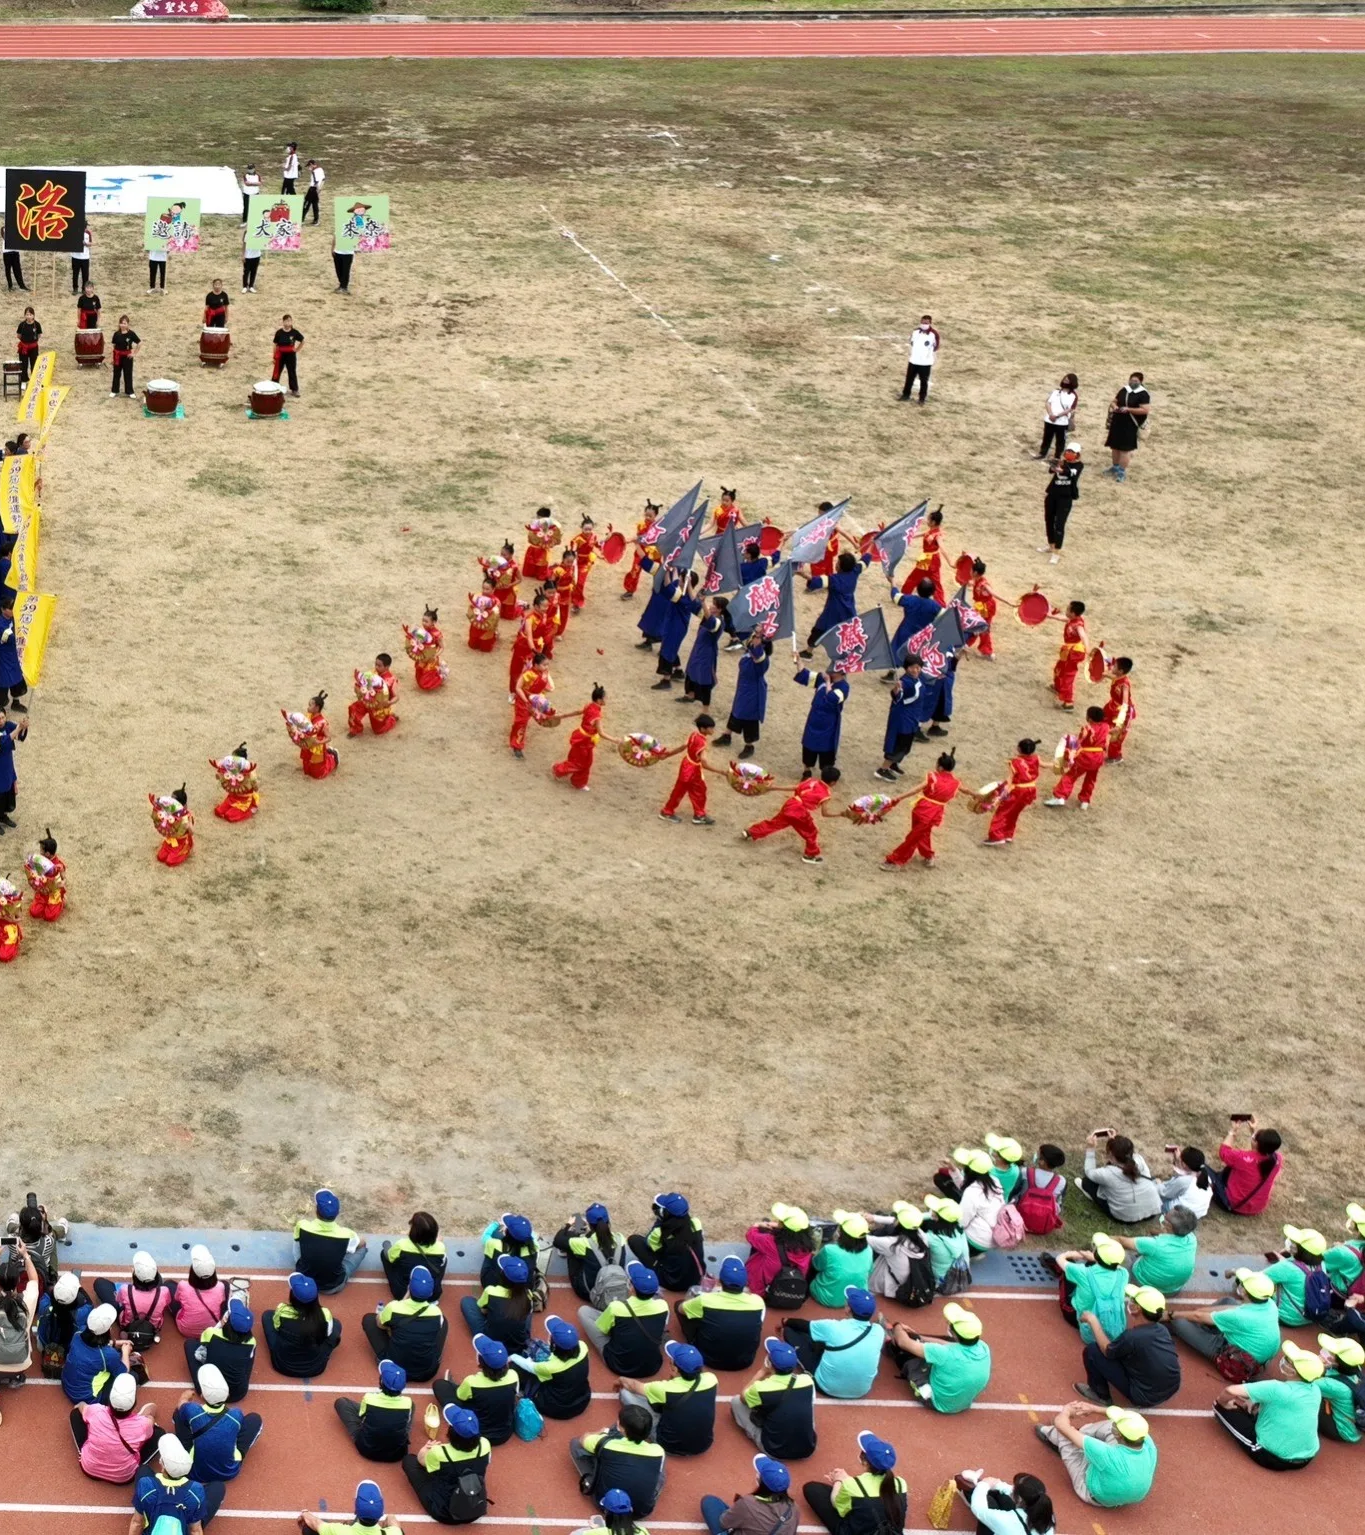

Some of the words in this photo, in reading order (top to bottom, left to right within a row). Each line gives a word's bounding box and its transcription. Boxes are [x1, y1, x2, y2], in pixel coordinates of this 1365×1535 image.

[165, 1, 198, 13] 聖火台
[15, 179, 74, 240] 洛
[152, 220, 191, 240] 邀請
[254, 219, 293, 238] 大家
[343, 217, 383, 238] 來寮
